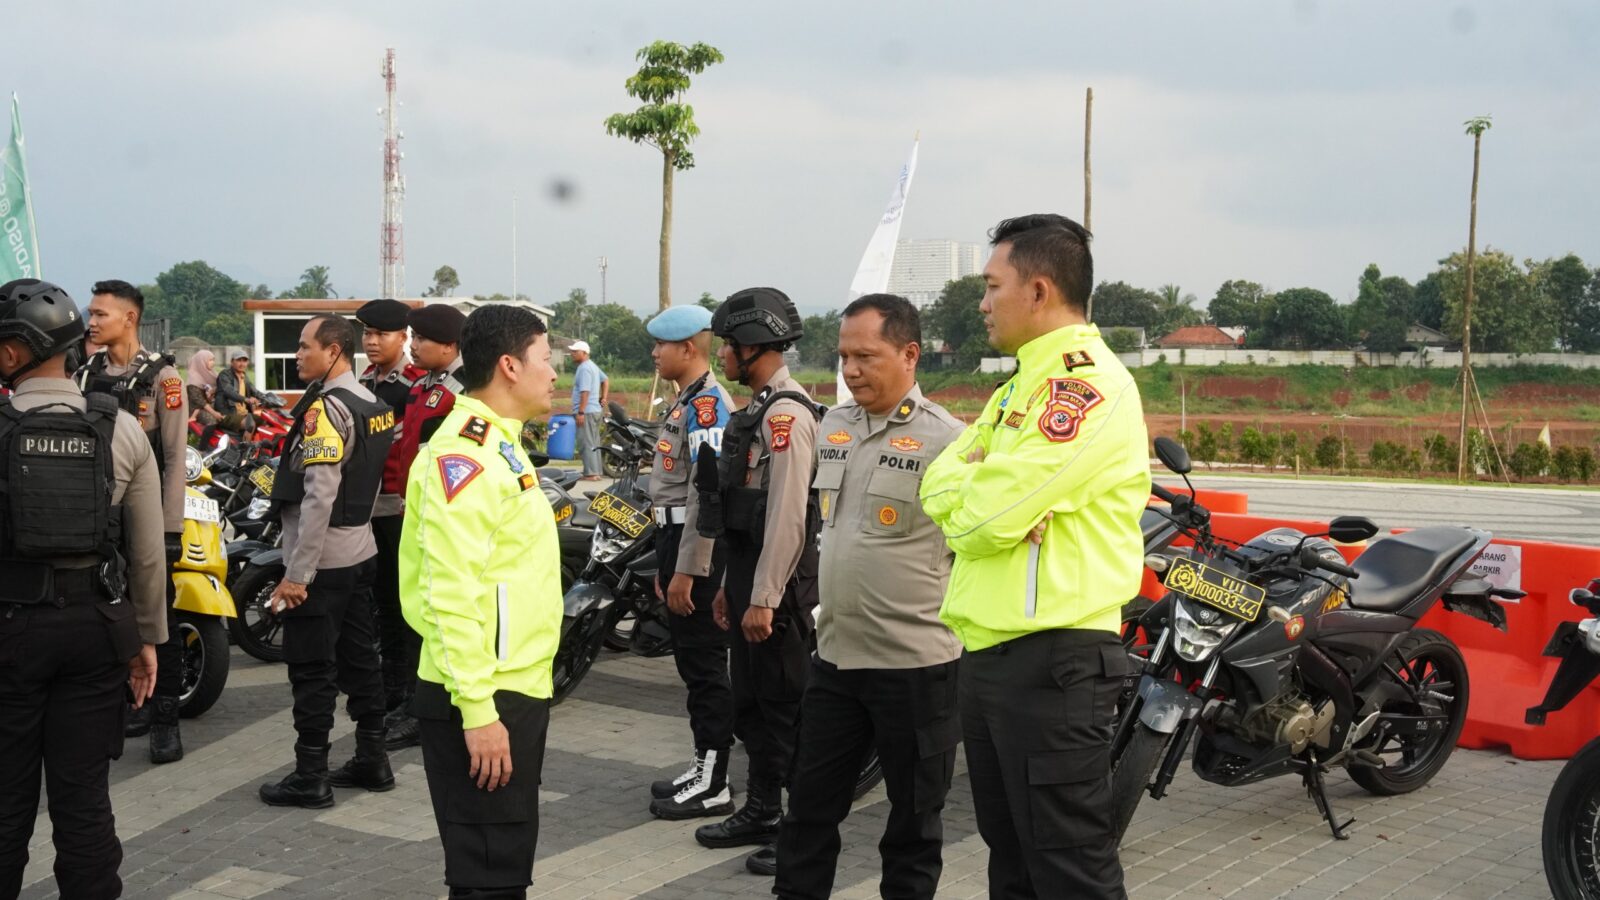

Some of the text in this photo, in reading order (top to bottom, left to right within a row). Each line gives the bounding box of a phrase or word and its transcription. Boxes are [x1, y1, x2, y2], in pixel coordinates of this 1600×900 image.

[69, 310, 75, 321] 9
[369, 410, 394, 434] POLISI
[26, 438, 90, 454] POLICE
[688, 427, 725, 458] PRO
[820, 448, 849, 460] YUDI.K
[879, 455, 920, 472] POLRI
[554, 503, 573, 522] LISI
[1222, 577, 1246, 593] VIII
[1196, 580, 1257, 617] 100033-44
